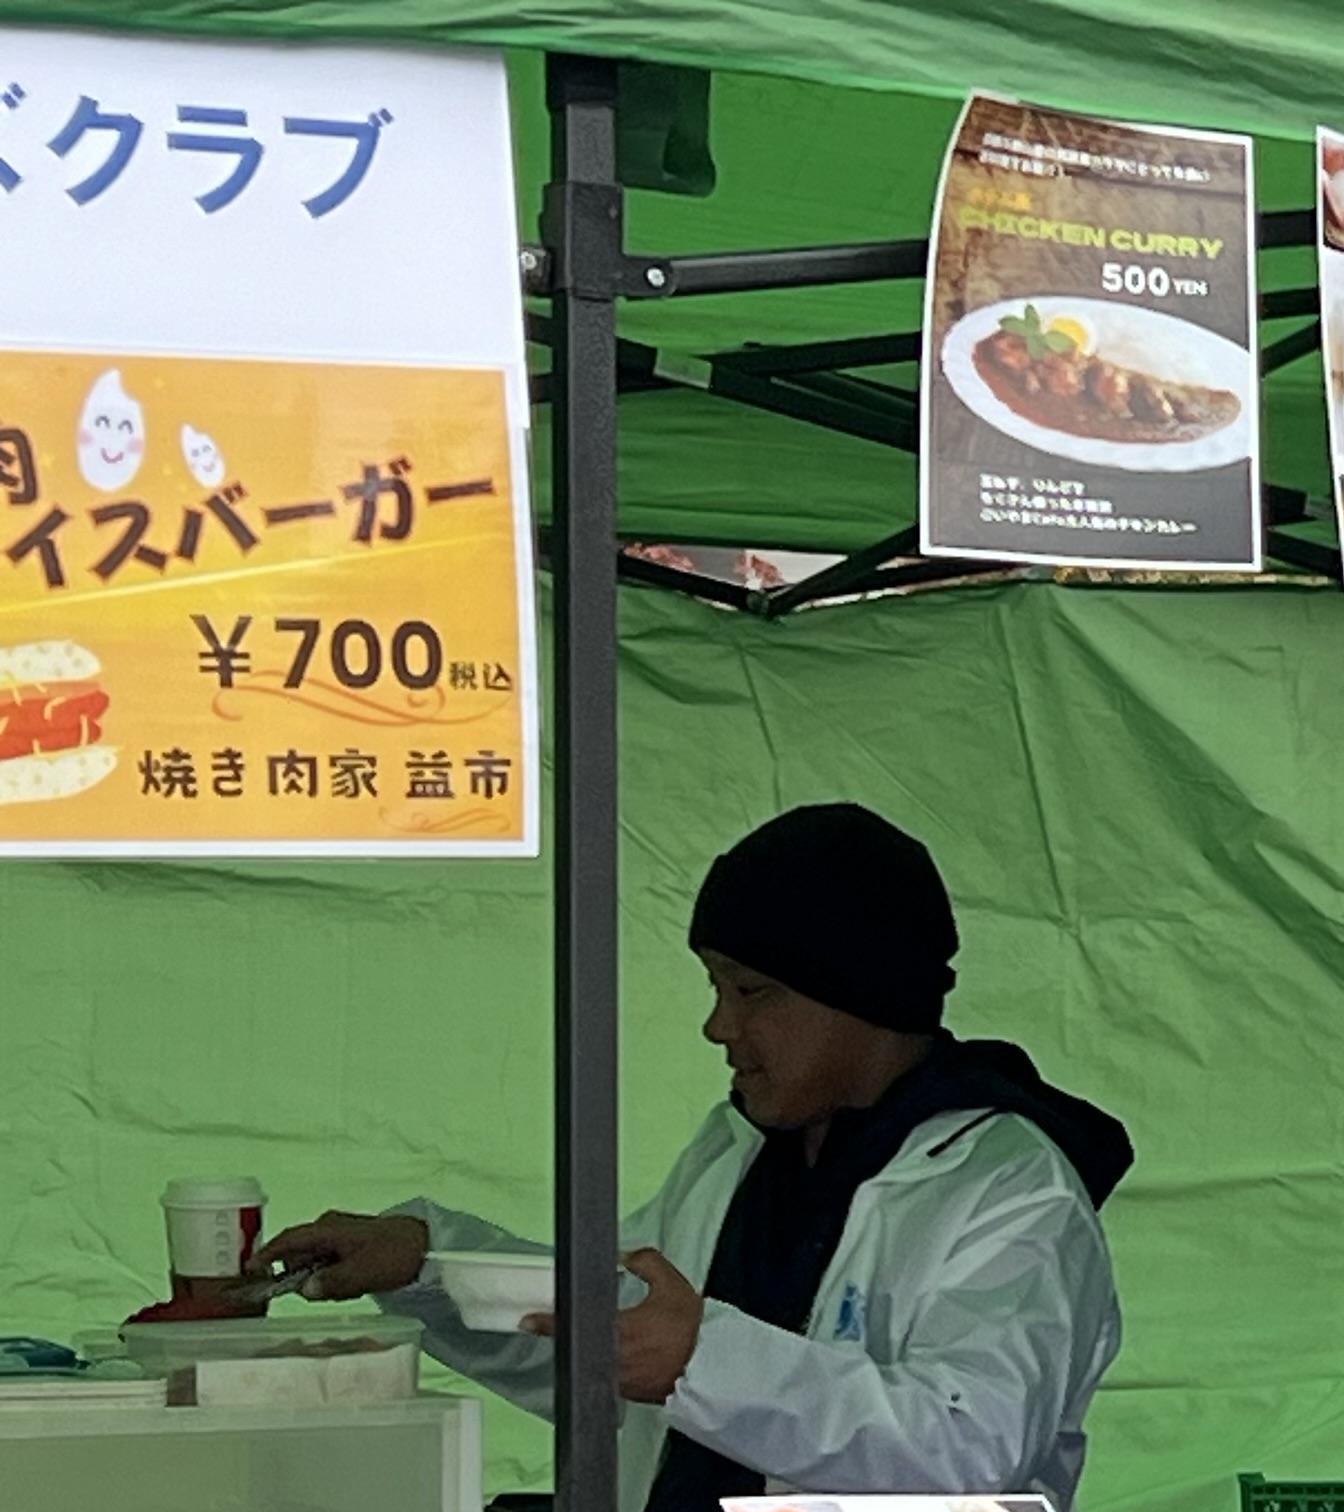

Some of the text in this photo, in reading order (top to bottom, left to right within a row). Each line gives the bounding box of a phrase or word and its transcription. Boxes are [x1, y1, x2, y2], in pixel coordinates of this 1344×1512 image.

[0, 82, 392, 219] クラブ
[958, 209, 1225, 260] CHICKEN CURRY
[1101, 262, 1208, 297] 500 YEN
[4, 456, 498, 590] イスバーガー
[449, 660, 513, 692] 税込
[138, 747, 512, 801] 焼き肉家 益市
